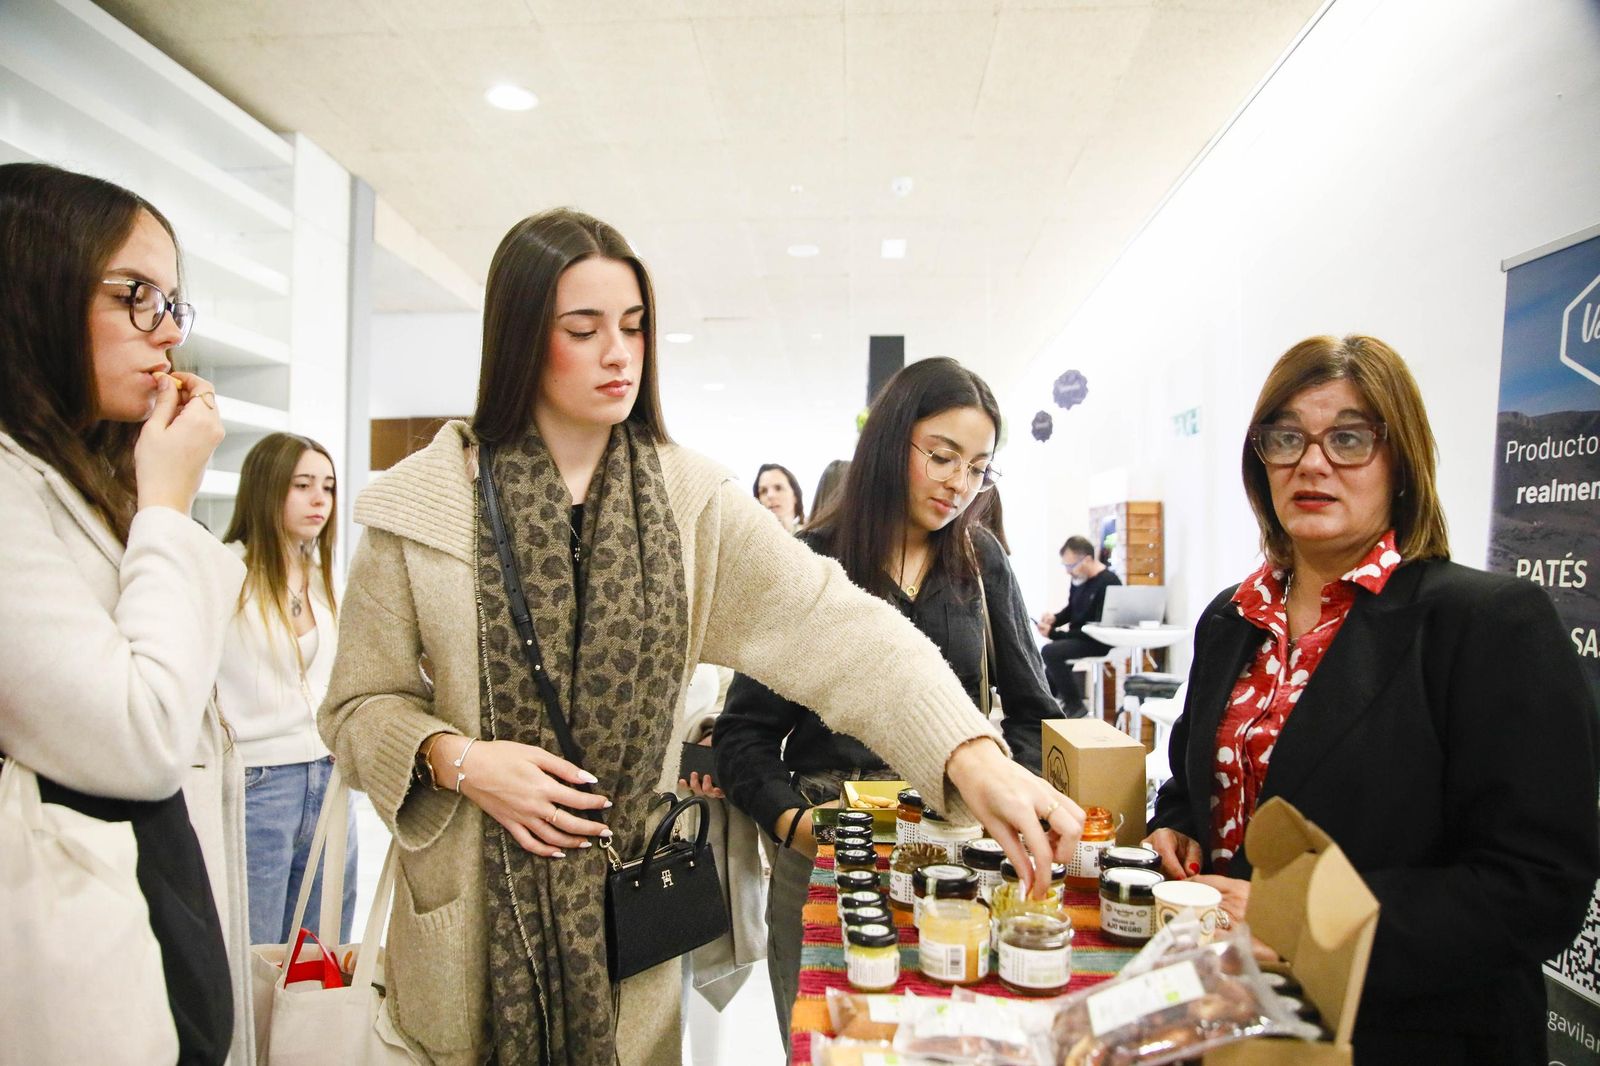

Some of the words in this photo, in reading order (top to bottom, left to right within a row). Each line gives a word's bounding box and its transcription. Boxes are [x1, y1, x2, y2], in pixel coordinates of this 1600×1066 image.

[1505, 434, 1600, 464] Producto
[1516, 551, 1588, 588] PATÉS
[1570, 627, 1600, 658] SA
[1107, 921, 1118, 929] AJO
[1119, 925, 1142, 933] NEGRO
